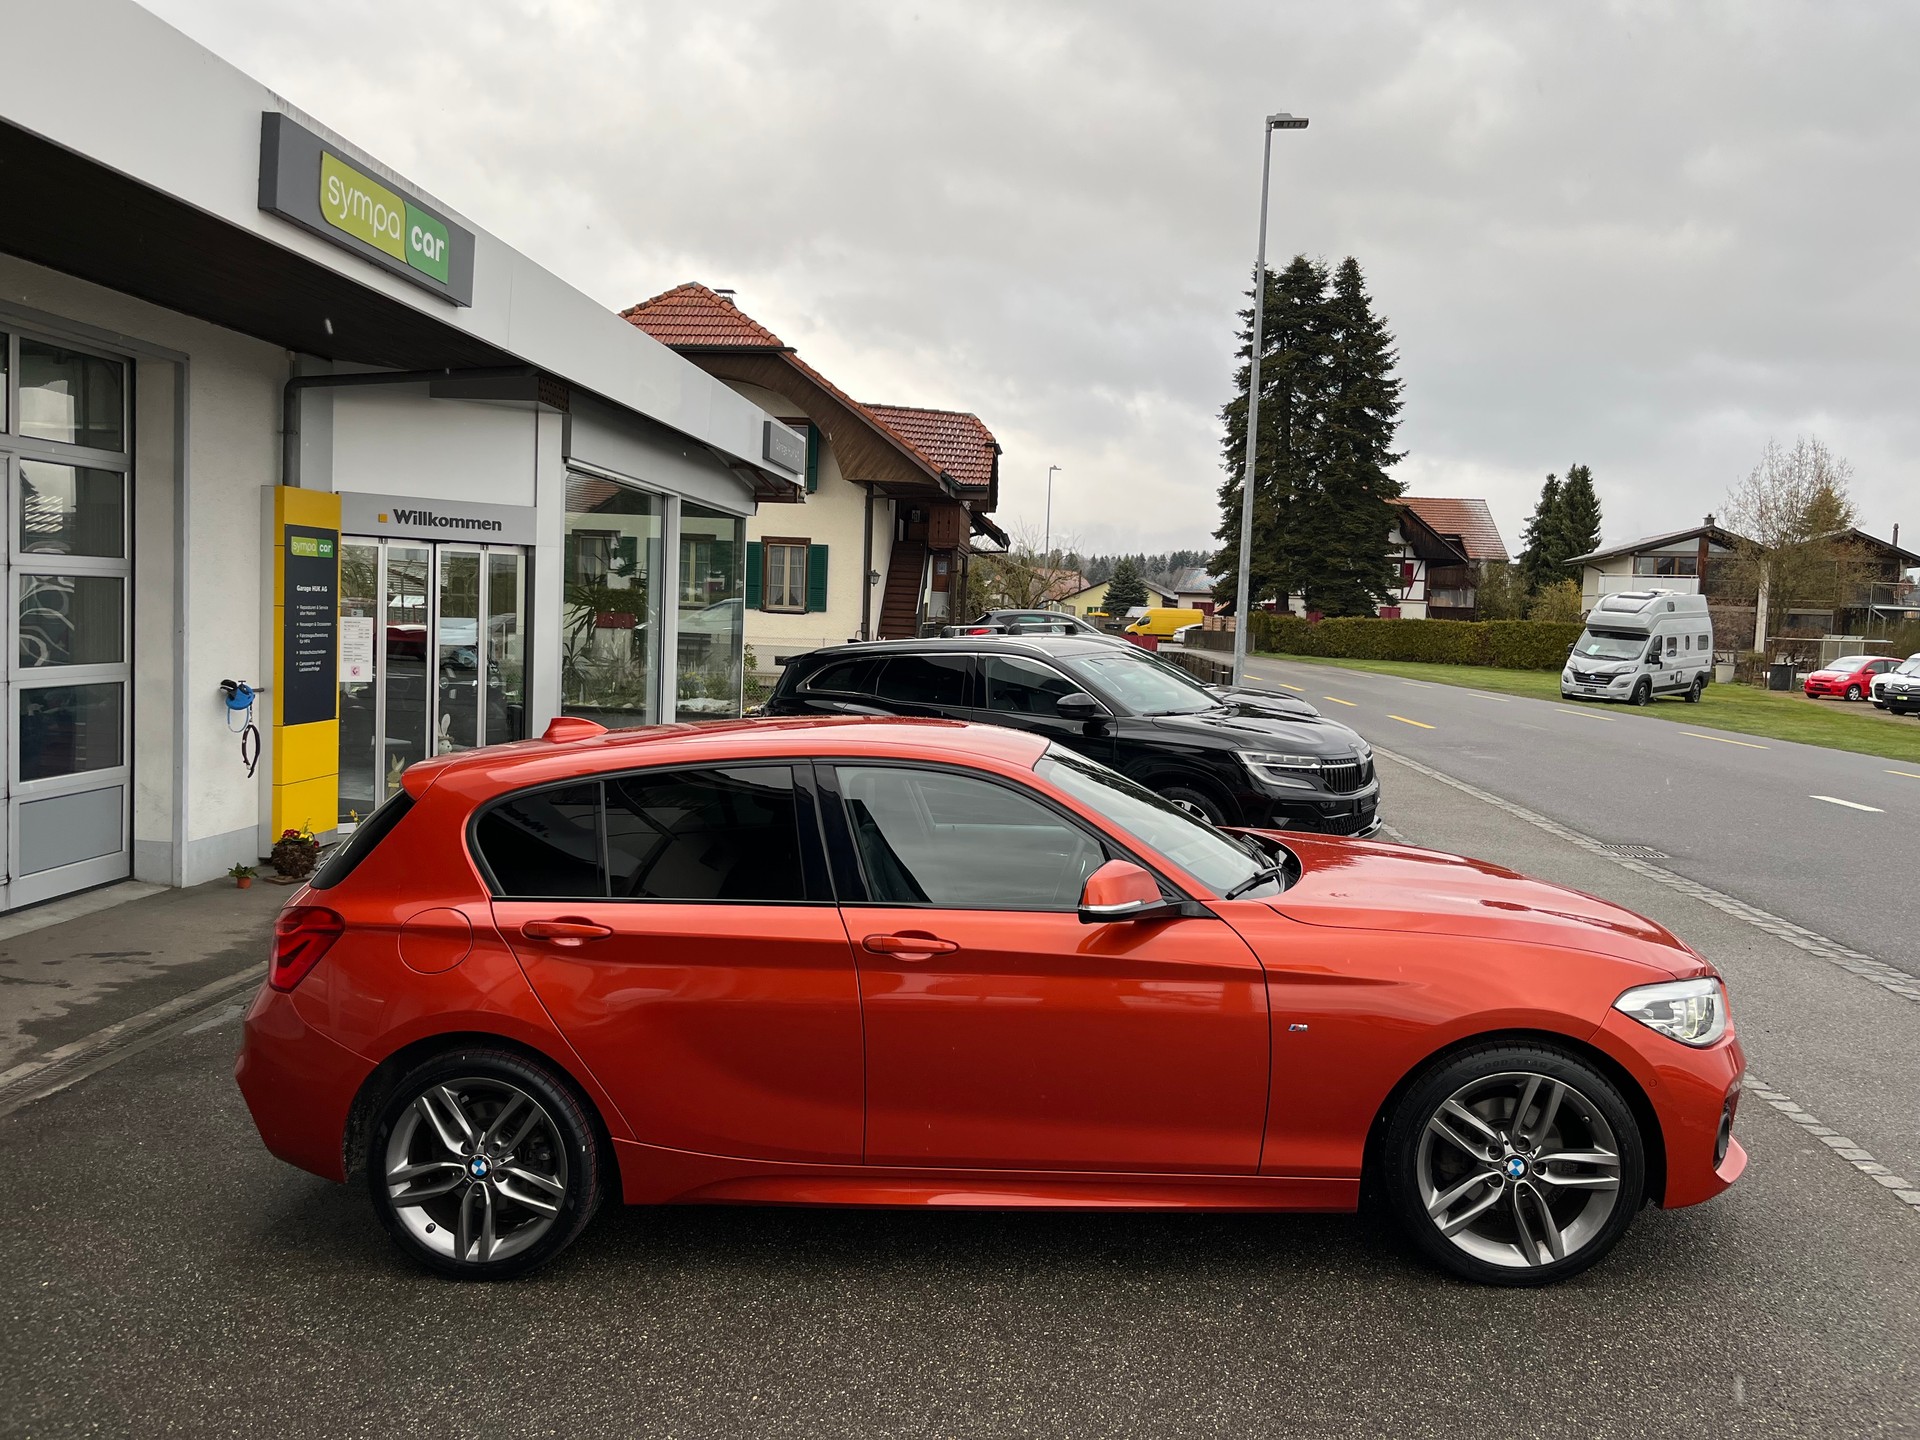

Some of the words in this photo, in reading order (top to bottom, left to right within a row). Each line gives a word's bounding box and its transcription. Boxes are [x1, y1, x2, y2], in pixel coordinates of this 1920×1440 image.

[328, 175, 400, 240] sympa
[411, 225, 445, 262] car
[392, 508, 502, 532] Willkommen
[292, 541, 317, 553] sympa
[319, 543, 332, 553] car
[296, 584, 312, 593] Garage
